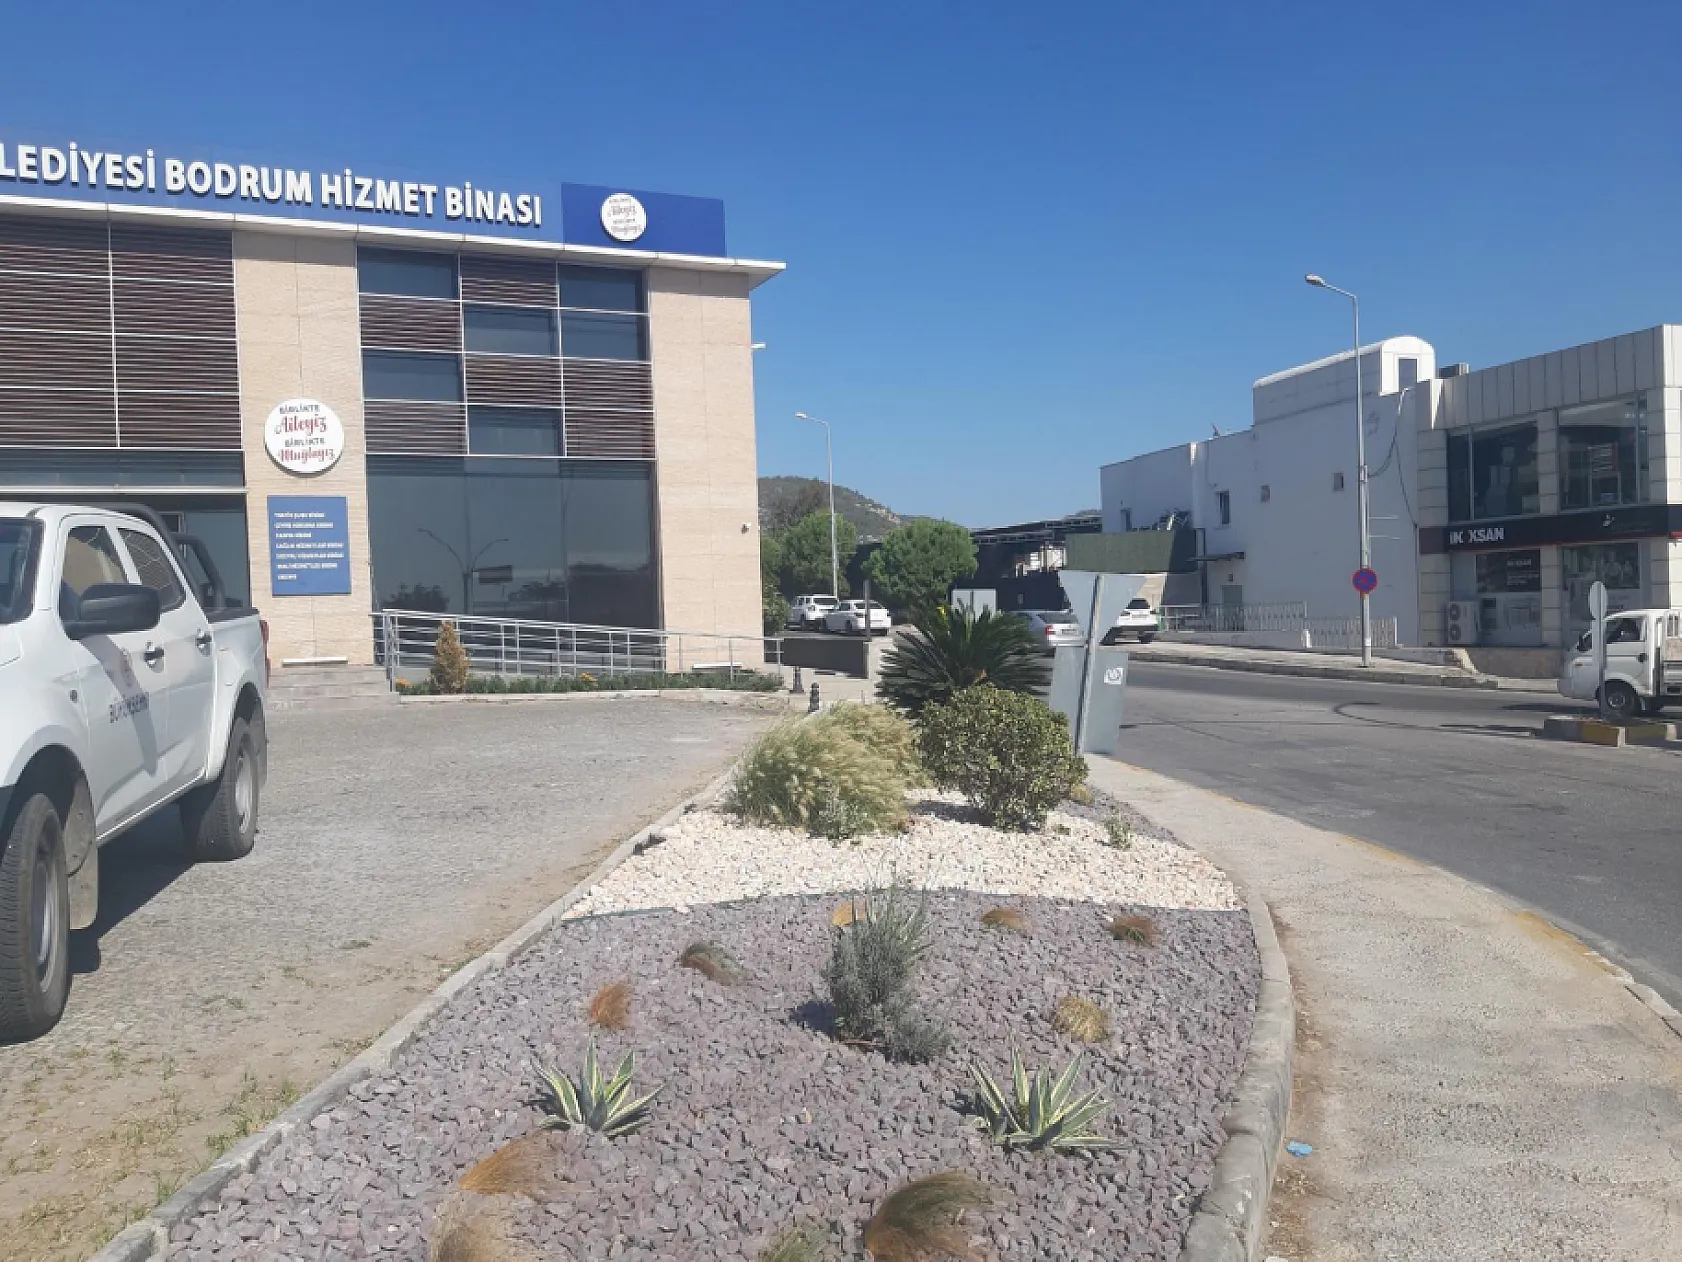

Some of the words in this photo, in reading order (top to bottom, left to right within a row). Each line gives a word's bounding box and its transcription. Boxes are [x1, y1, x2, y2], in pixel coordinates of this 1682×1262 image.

[0, 141, 155, 189] LEDİYESİ
[165, 157, 312, 203] BODRUM
[321, 168, 438, 215] HİZMET
[445, 182, 541, 226] BİNASI
